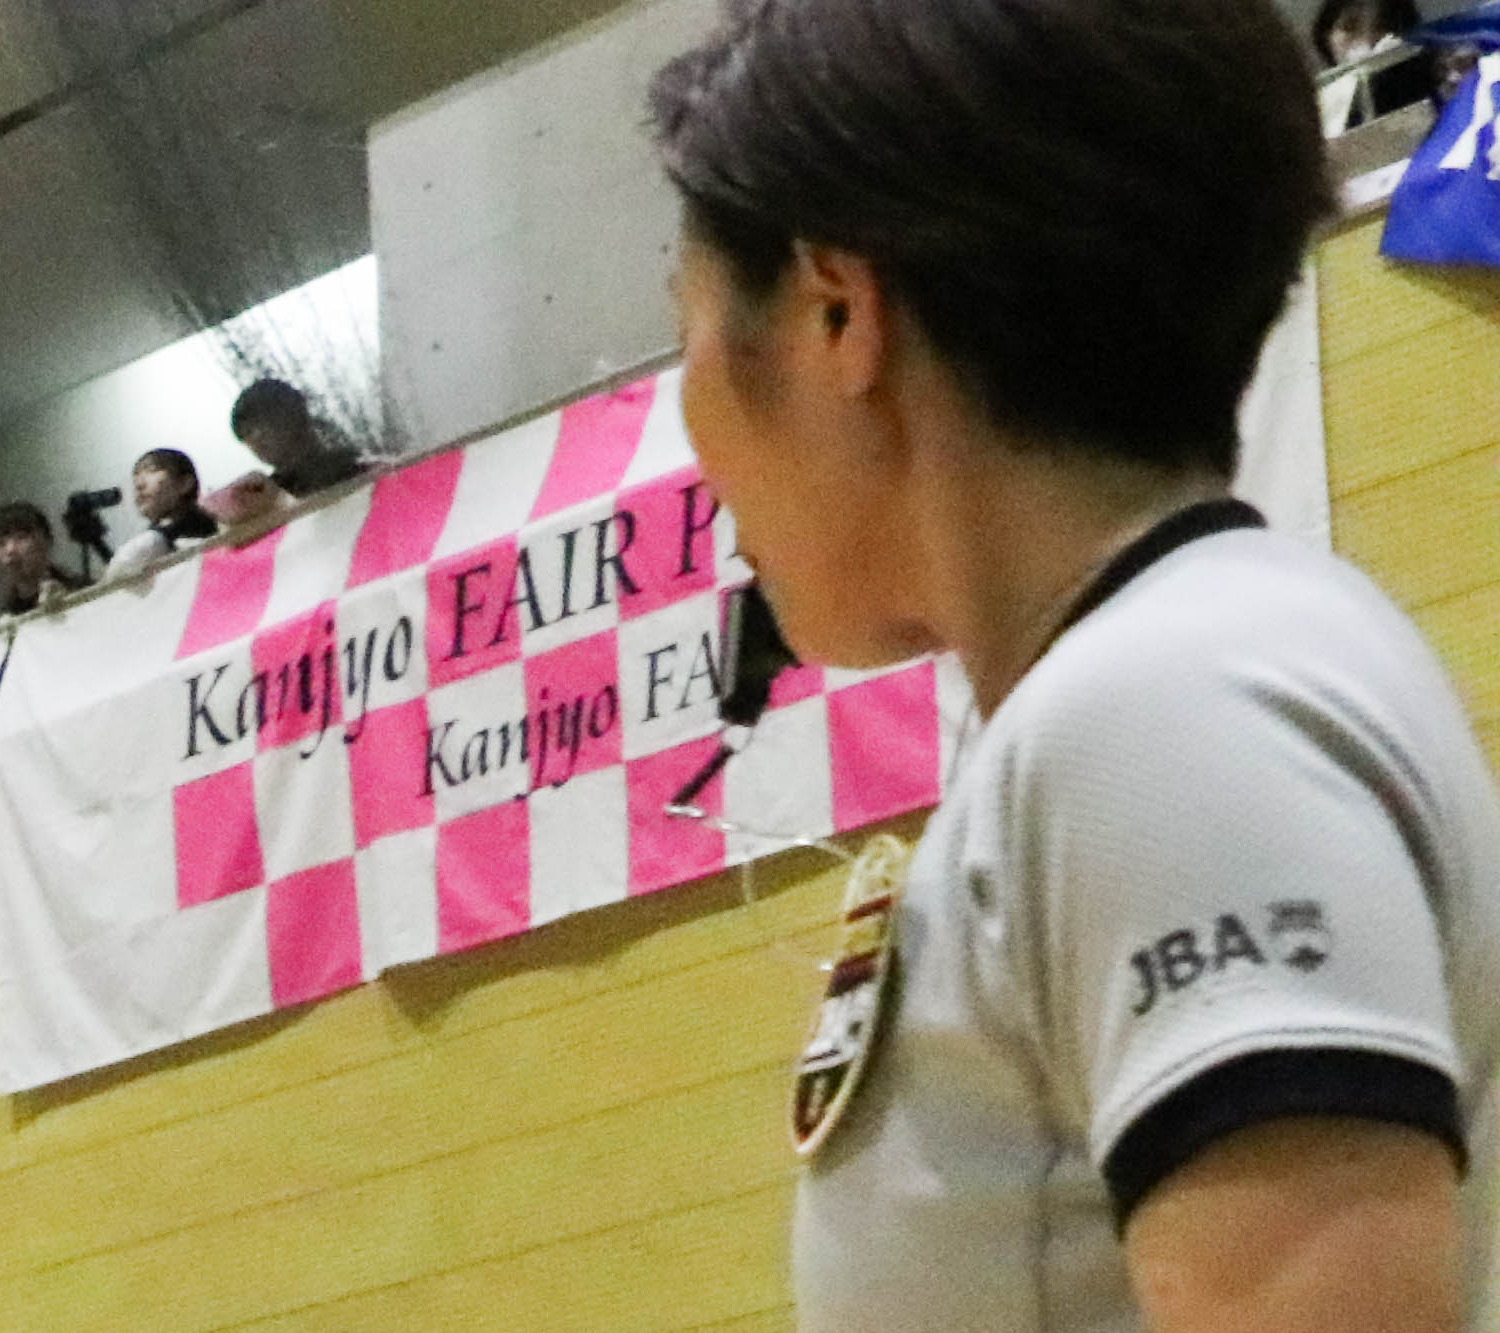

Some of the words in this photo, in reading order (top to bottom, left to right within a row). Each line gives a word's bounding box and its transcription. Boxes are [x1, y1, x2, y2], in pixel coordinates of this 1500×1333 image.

[181, 612, 413, 761] Kanjyo
[443, 508, 643, 663] FAIR
[417, 682, 619, 800] Kanjyo
[1127, 912, 1267, 1017] JBA
